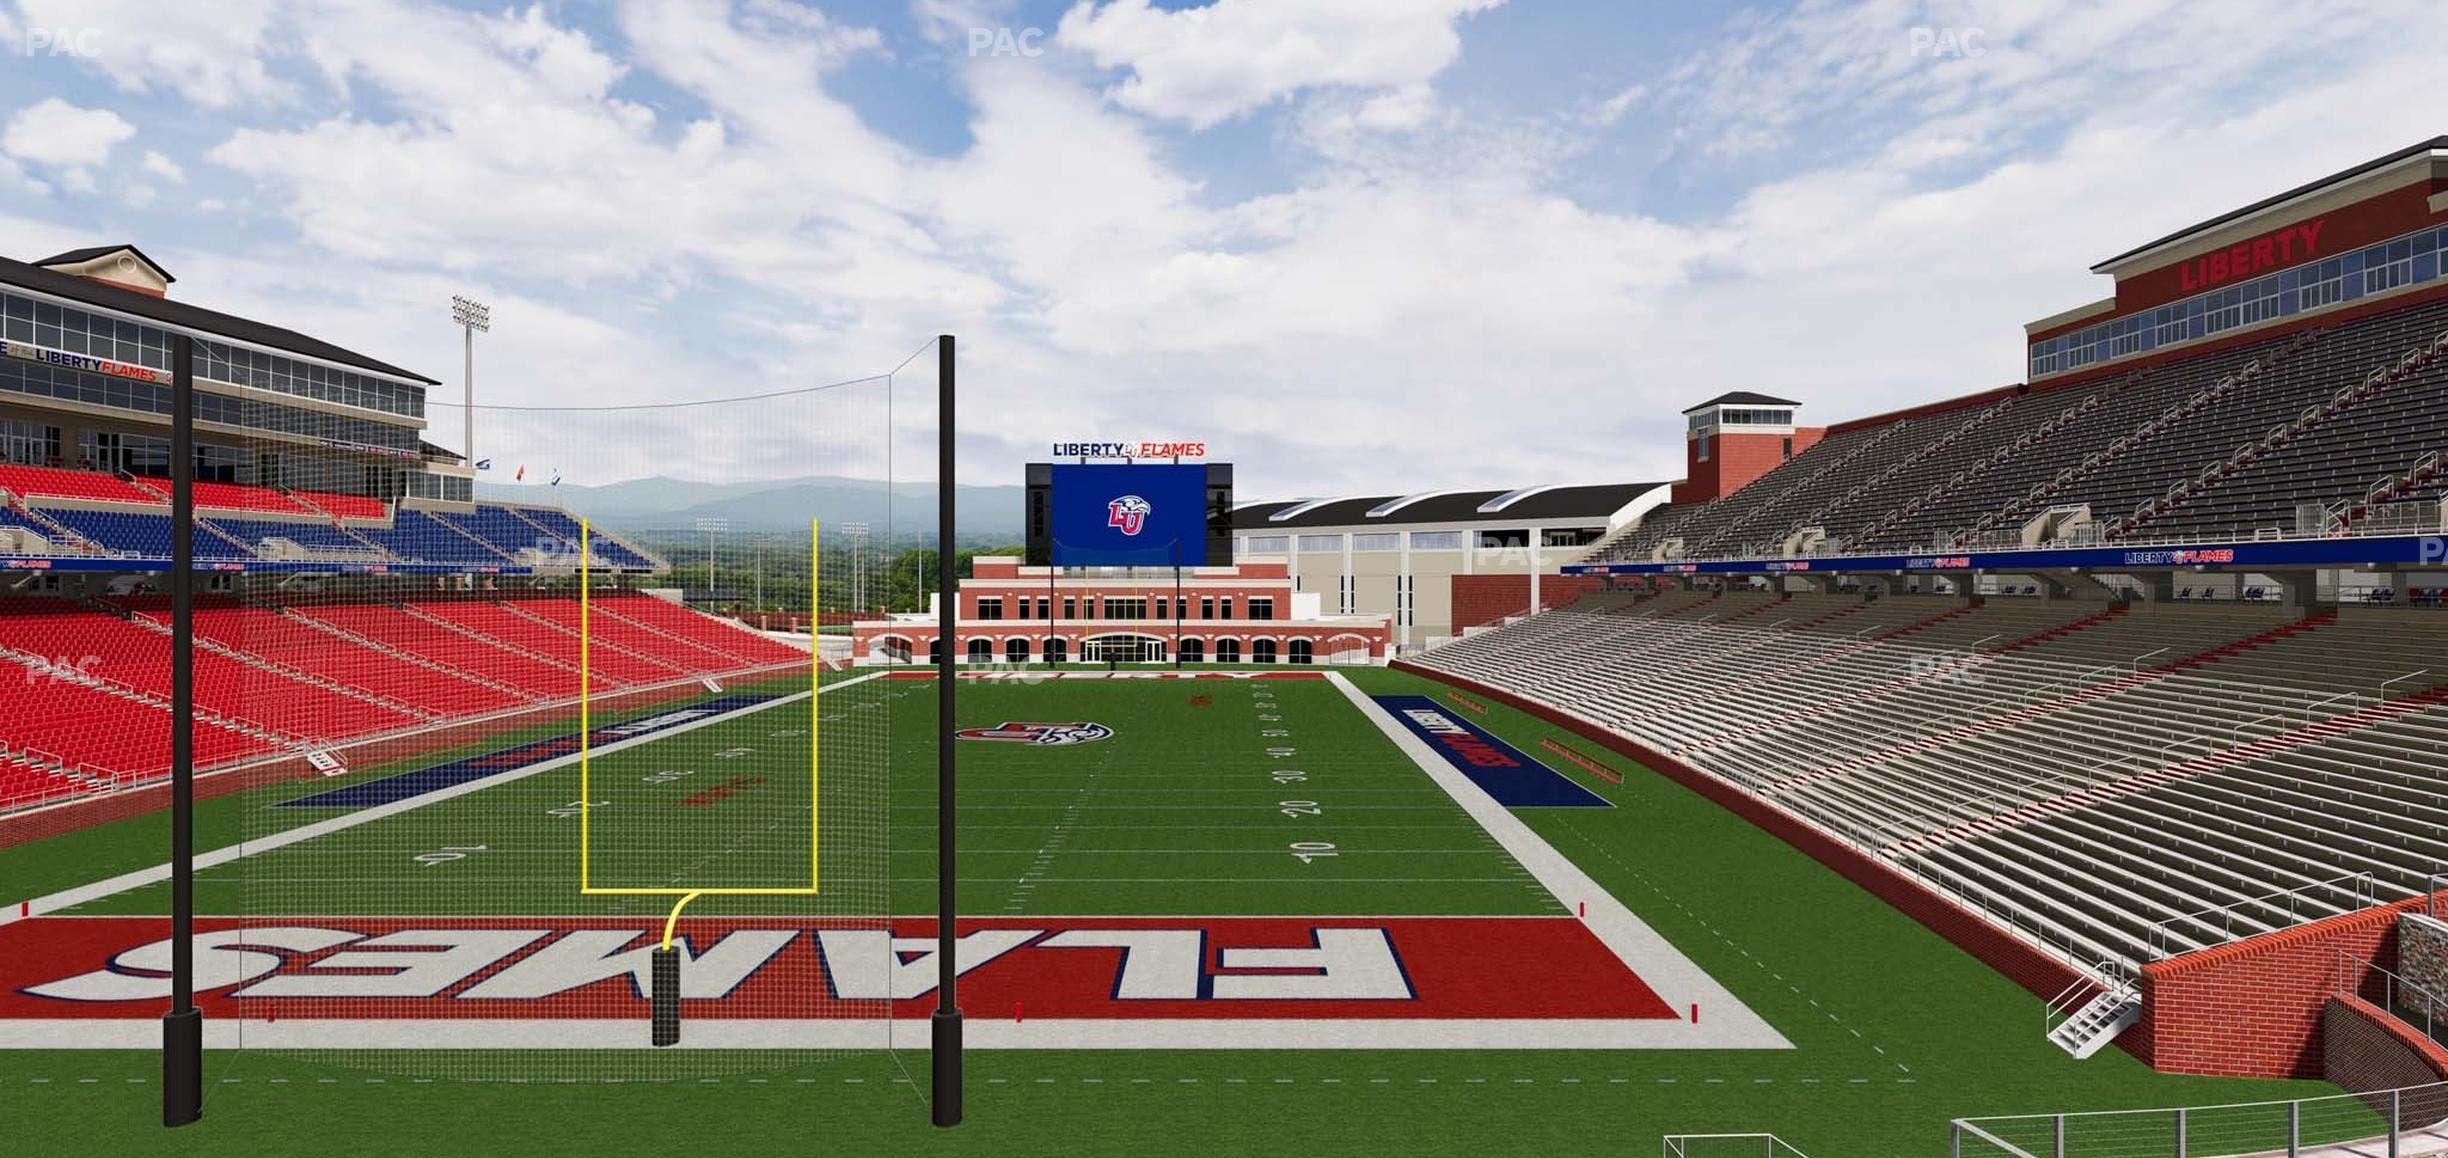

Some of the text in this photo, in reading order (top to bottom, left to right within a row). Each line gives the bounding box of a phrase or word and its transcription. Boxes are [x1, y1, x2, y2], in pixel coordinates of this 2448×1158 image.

[2180, 219, 2325, 292] LIBERTY
[1053, 442, 1124, 457] LIBERTY
[1140, 442, 1205, 457] FLAMES
[2124, 549, 2234, 565] LIBERTY FLAMES
[1279, 800, 1323, 816] 20
[413, 844, 488, 863] 10
[1288, 842, 1340, 859] 10
[14, 926, 1419, 1002] FLAMES
